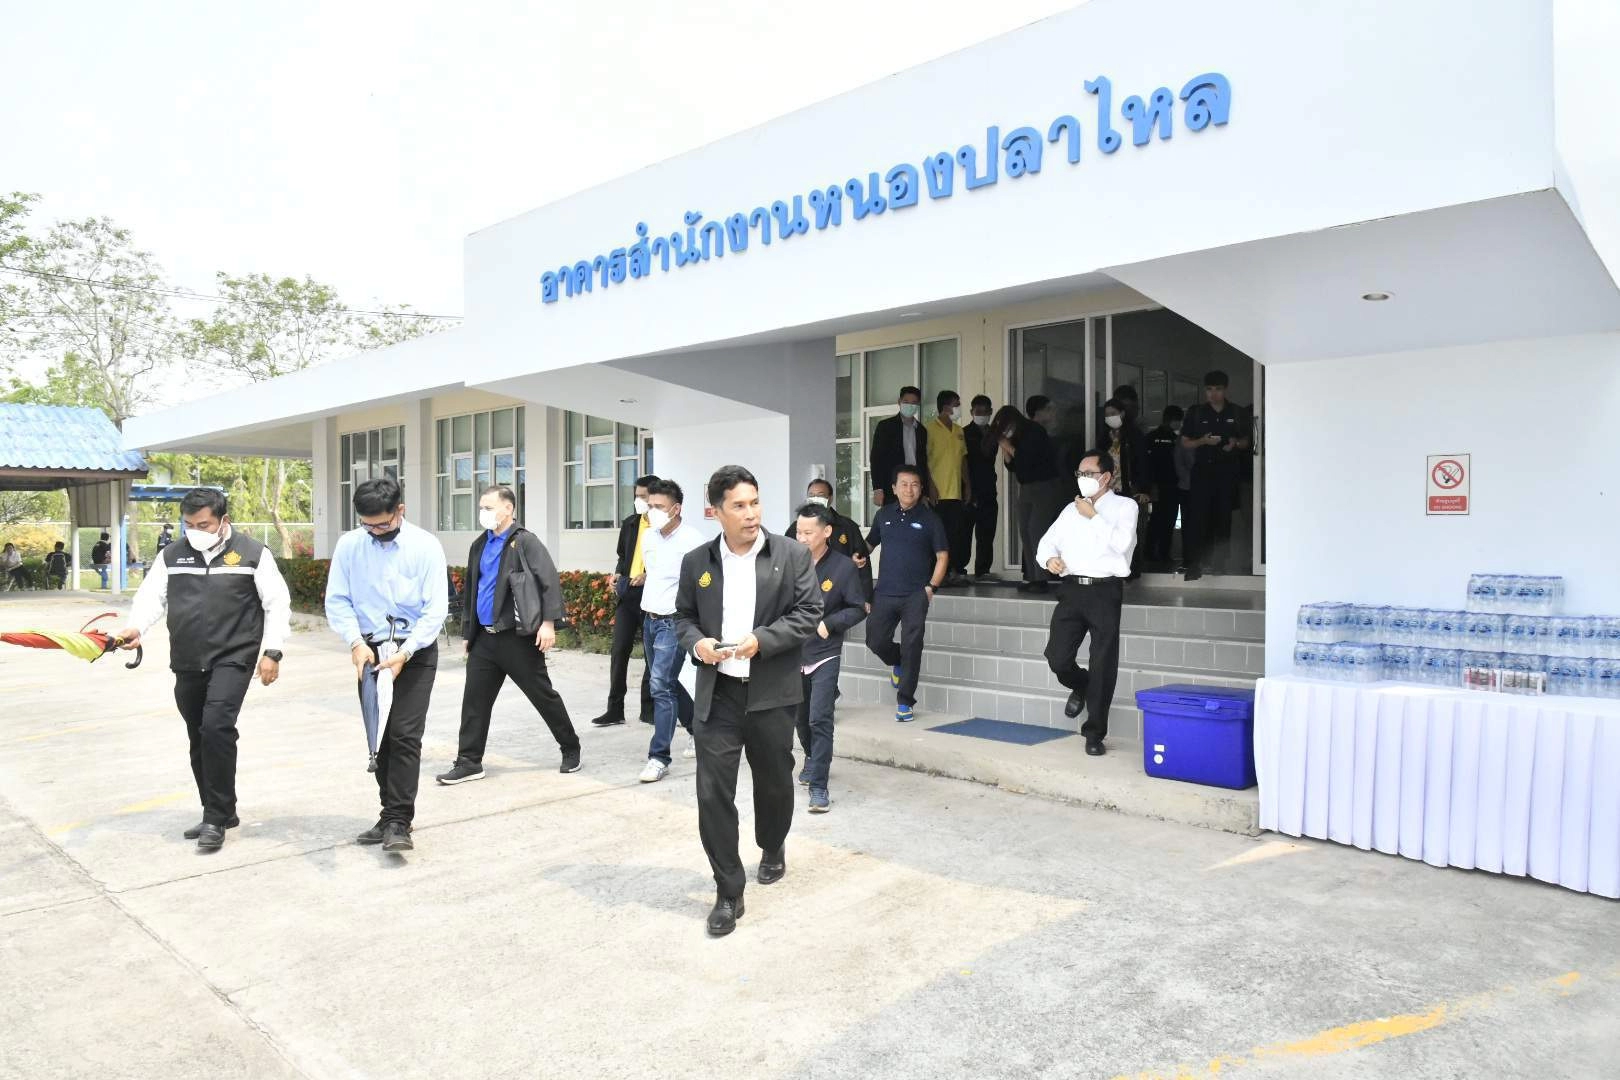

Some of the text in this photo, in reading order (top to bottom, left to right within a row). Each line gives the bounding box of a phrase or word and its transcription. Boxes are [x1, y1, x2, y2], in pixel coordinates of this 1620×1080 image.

[540, 73, 1232, 303] อาคารสำนักงานหนองปลาไหล
